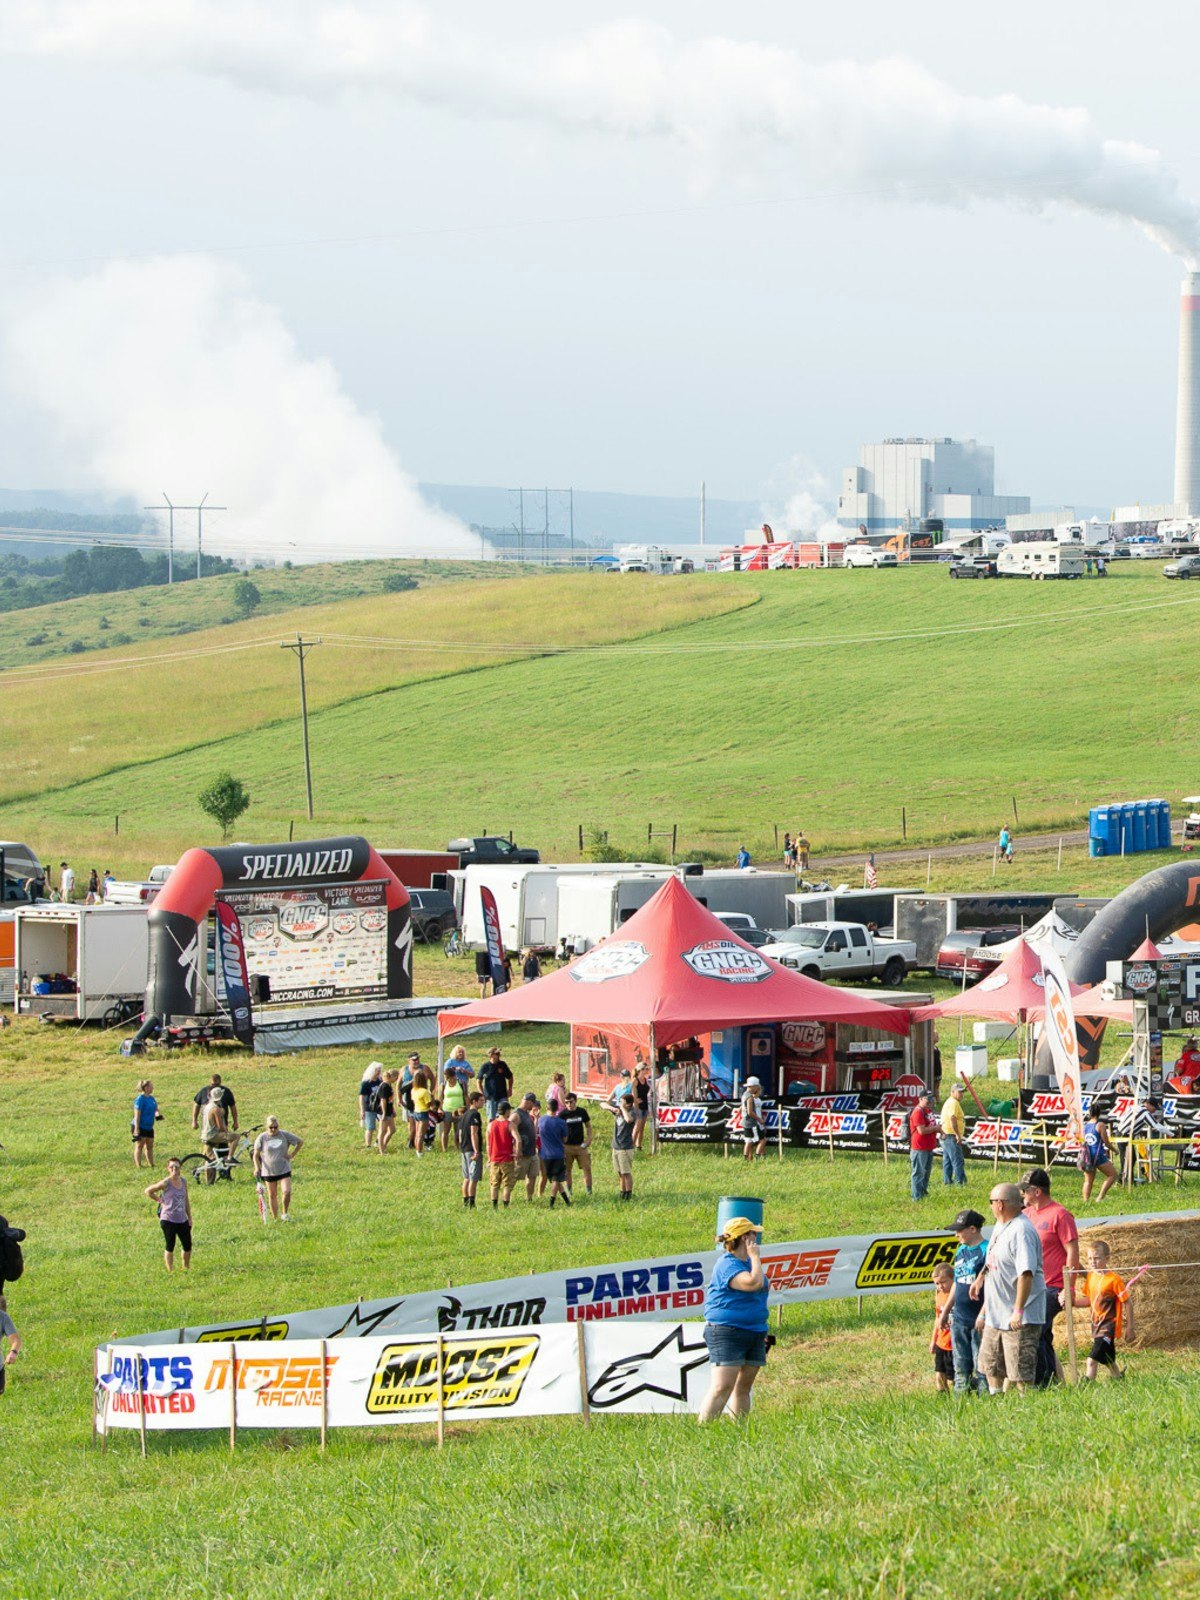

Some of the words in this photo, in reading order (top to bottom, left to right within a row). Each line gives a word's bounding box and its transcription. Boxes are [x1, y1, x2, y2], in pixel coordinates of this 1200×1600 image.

[239, 849, 354, 880] SPECIALIZED
[255, 892, 285, 901] VICTORY
[325, 887, 353, 897] VICTORY
[331, 896, 350, 906] LANE
[254, 902, 274, 911] LANE
[281, 905, 328, 926] GNCC
[486, 906, 503, 968] 100%
[700, 941, 736, 950] AMSOIL
[221, 921, 244, 990] 100%
[694, 952, 762, 969] GNCC
[1127, 972, 1156, 983] GNCC
[784, 1025, 824, 1043] GNCC
[896, 1085, 924, 1097] STOP
[799, 1095, 858, 1110] AMSOIL
[1031, 1095, 1092, 1114] AMSIL
[657, 1106, 708, 1125] MSOIL
[726, 1109, 790, 1128] AOIL
[807, 1114, 865, 1134] AMSOIL
[983, 1150, 996, 1158] Firs
[1187, 1160, 1200, 1168] The
[761, 1248, 841, 1280] OSE
[867, 1240, 960, 1271] MOOS
[566, 1261, 703, 1305] PARTS
[769, 1272, 829, 1292] RACING
[862, 1271, 909, 1284] UTILITY
[910, 1267, 935, 1280] DIVI
[461, 1297, 546, 1330] THOR
[566, 1288, 705, 1323] UNLIMITED
[111, 1355, 194, 1391] PARTS
[204, 1355, 340, 1391] MOOSE
[380, 1345, 524, 1390] MOOSE
[112, 1391, 196, 1414] UNLIMITED
[256, 1390, 327, 1407] RACING
[374, 1391, 432, 1406] UTILITY
